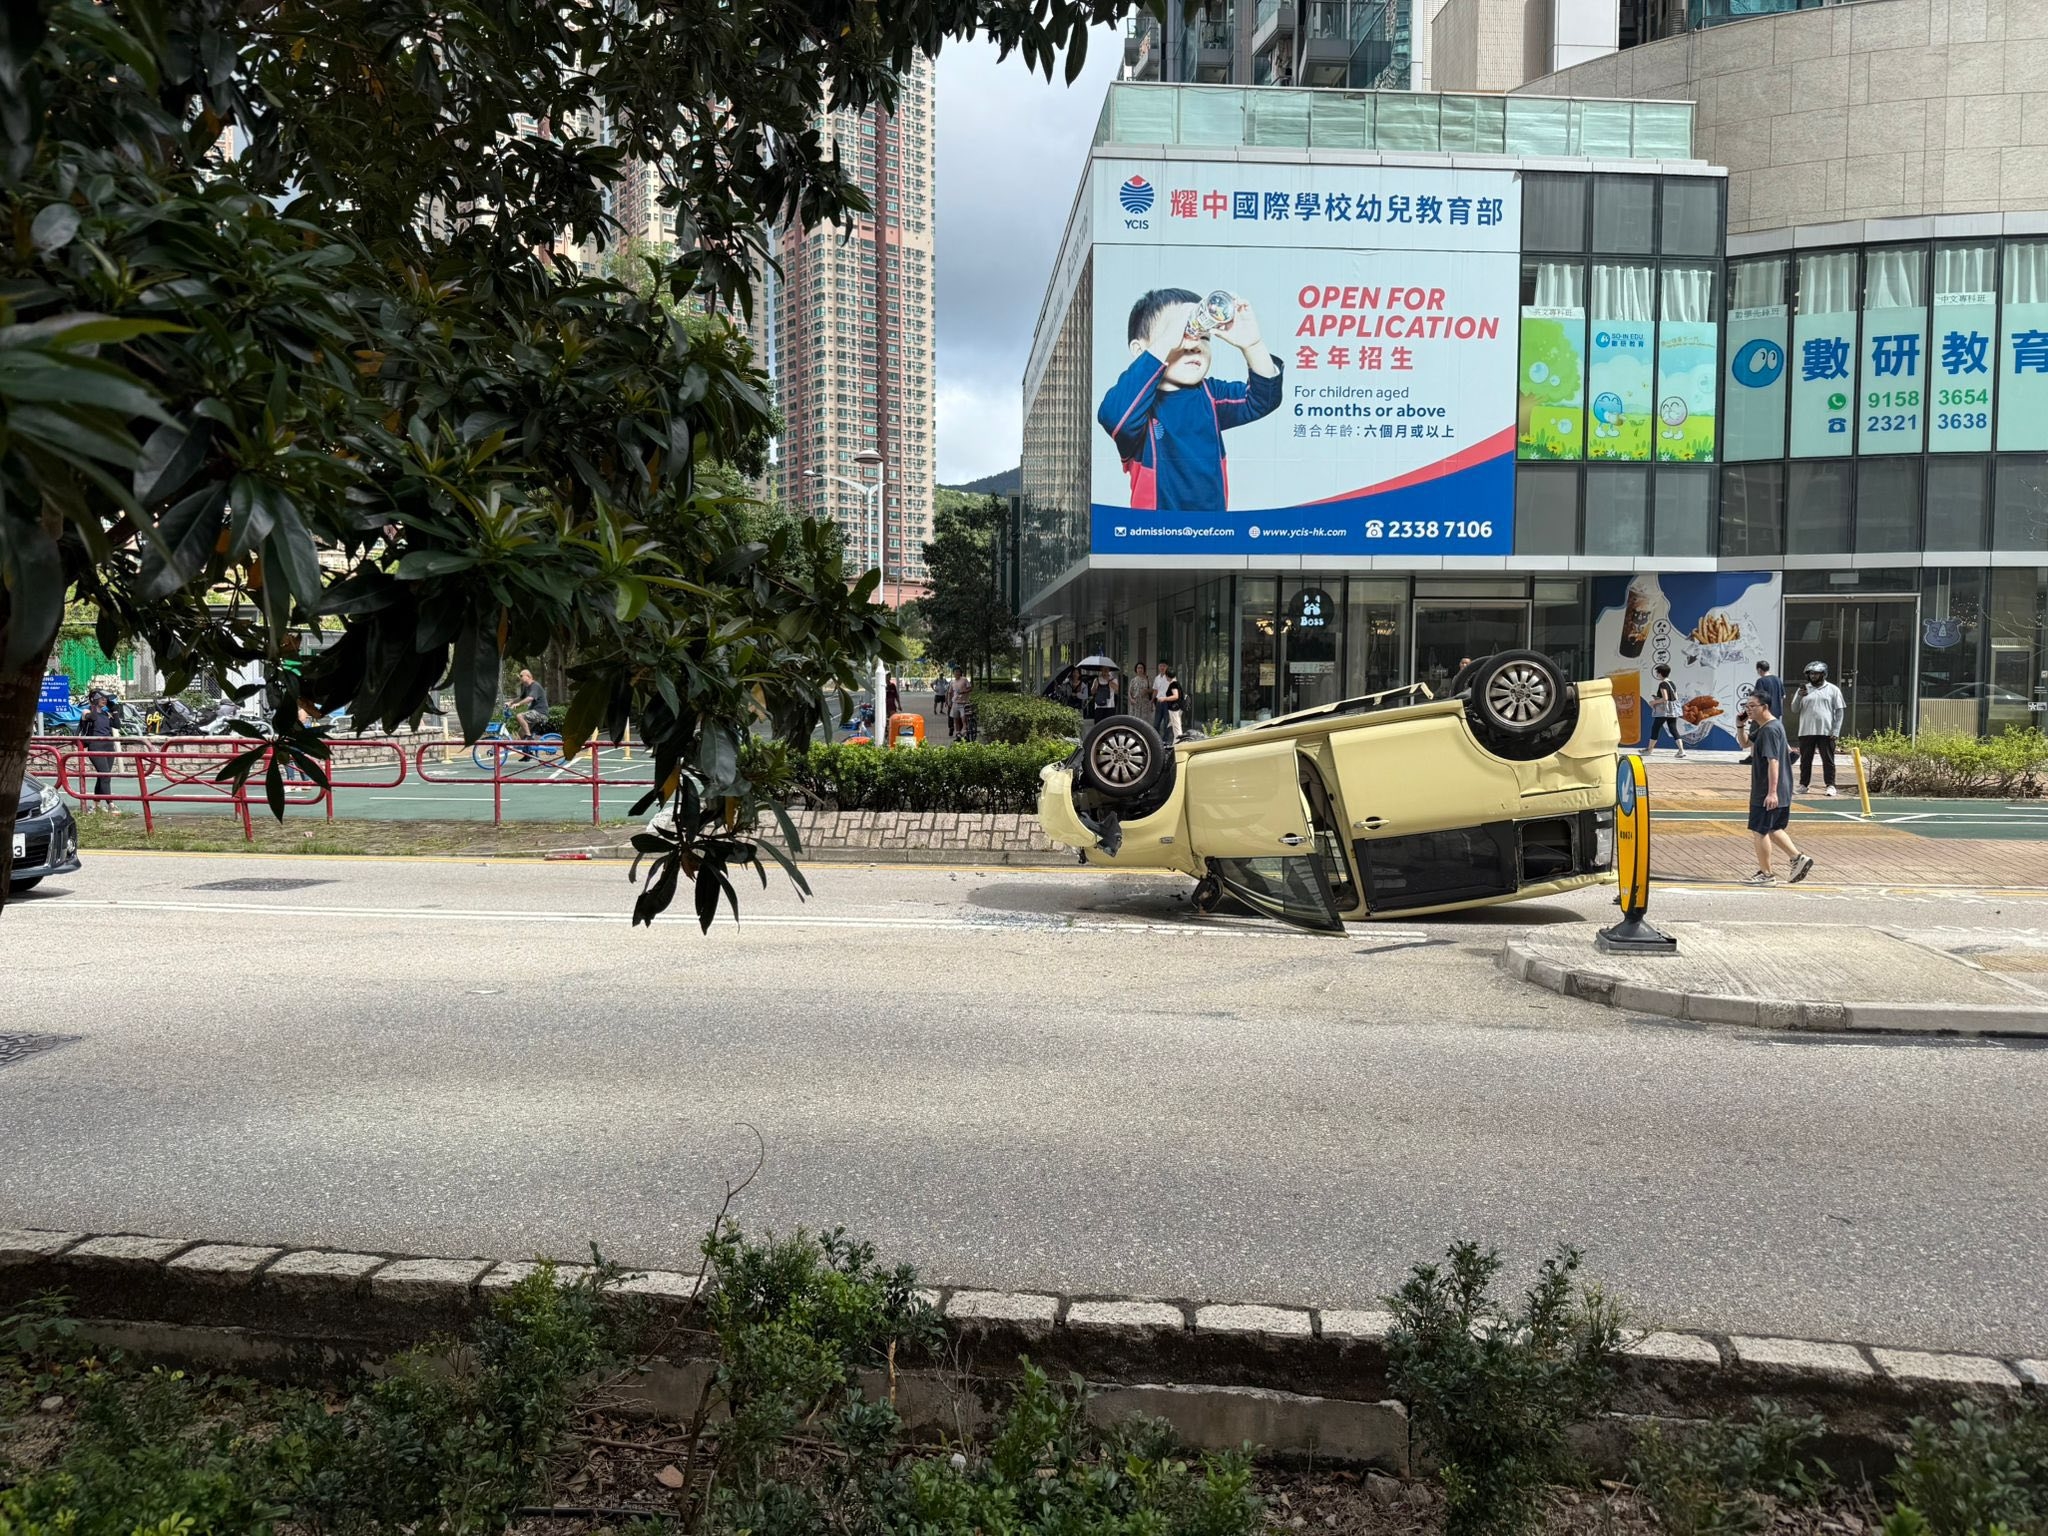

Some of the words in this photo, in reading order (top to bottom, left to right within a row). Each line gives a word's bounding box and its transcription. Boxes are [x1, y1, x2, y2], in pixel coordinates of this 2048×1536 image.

[1170, 188, 1504, 227] 耀中國際學校幼兒教育部
[1124, 219, 1149, 230] YCIS
[1298, 285, 1381, 310] OPEN
[1386, 287, 1446, 311] FOR
[1295, 314, 1500, 340] APPLICATION
[1295, 345, 1414, 371] 全年招生
[1294, 386, 1316, 399] For
[1319, 386, 1373, 399] children
[1376, 387, 1409, 401] aged
[1868, 390, 1920, 409] 9158
[1938, 388, 1989, 406] 3654
[1294, 403, 1304, 417] 6
[1307, 404, 1371, 418] months
[1375, 406, 1393, 418] or
[1396, 404, 1446, 418] above
[1867, 414, 1917, 432] 2321
[1937, 413, 1988, 430] 3638
[1129, 526, 1235, 539] admissions@ycef.com
[1262, 526, 1347, 539] www.ycis-hk.com
[1388, 521, 1439, 538] 2338
[1444, 521, 1493, 538] 7106
